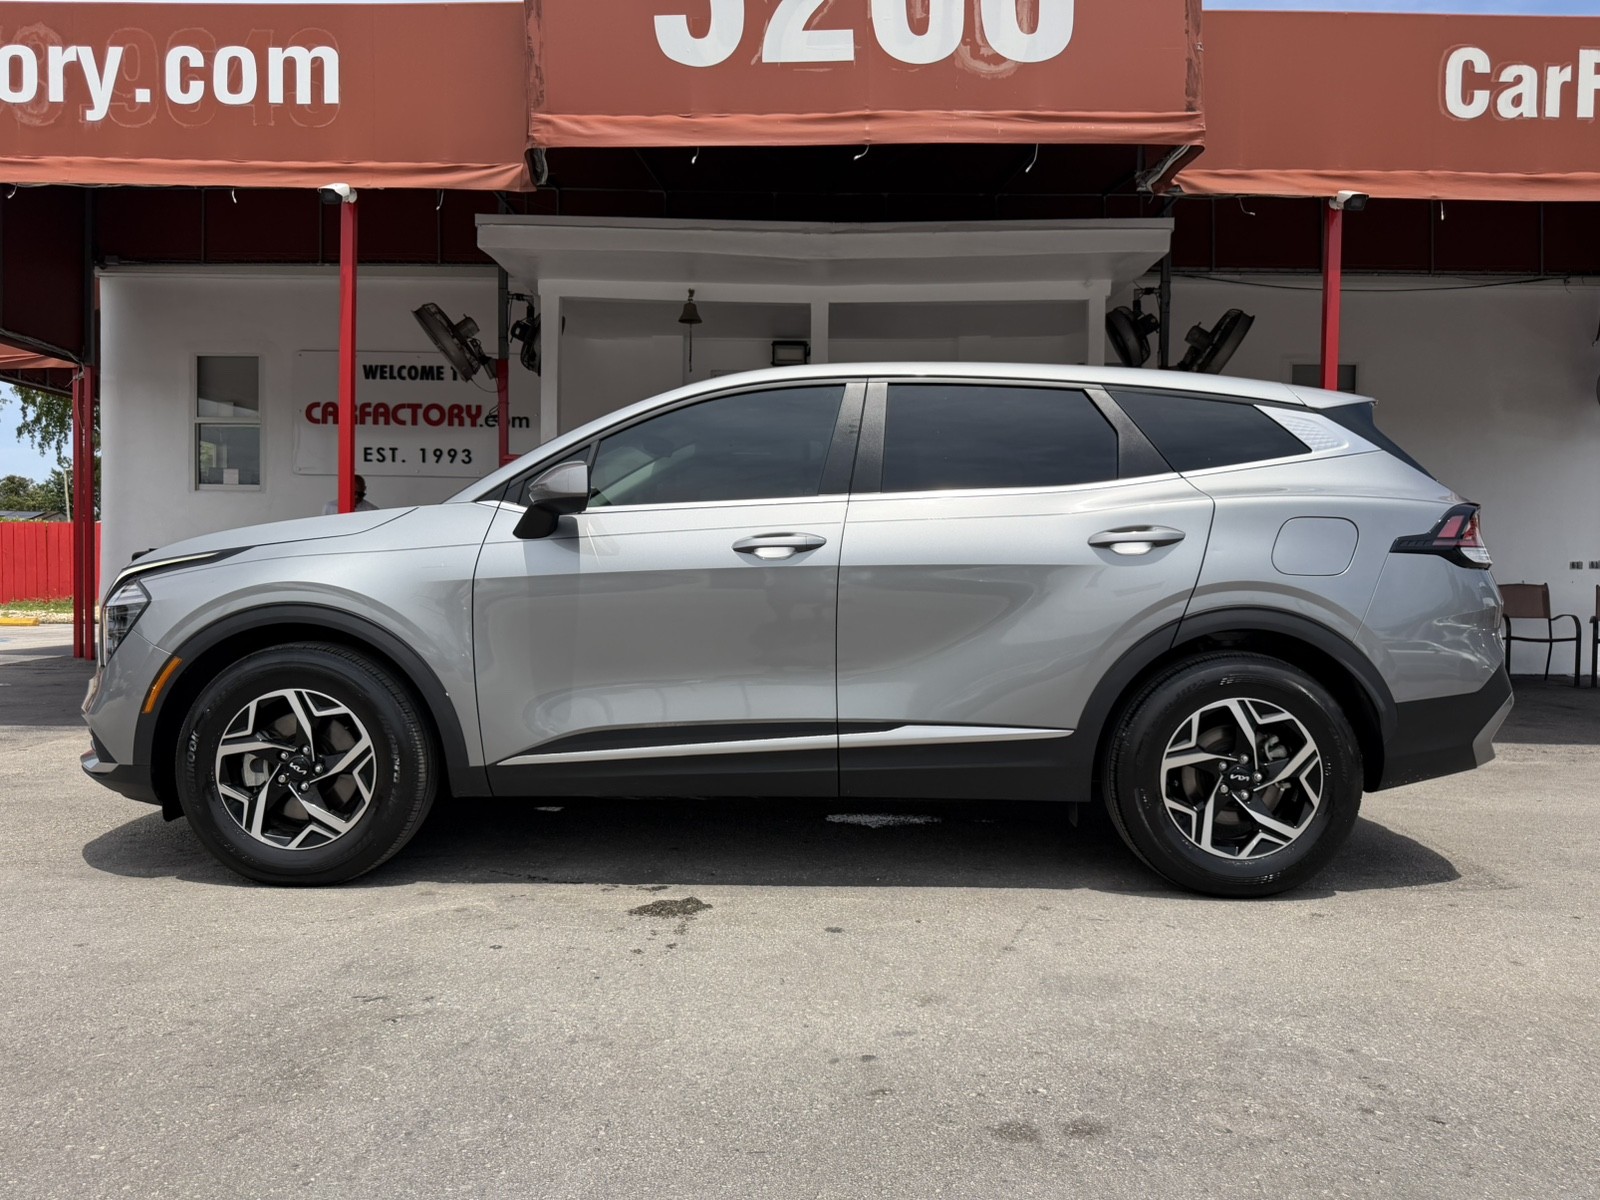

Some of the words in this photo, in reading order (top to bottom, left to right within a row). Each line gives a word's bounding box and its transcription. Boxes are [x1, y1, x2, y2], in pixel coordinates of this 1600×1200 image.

[0, 44, 340, 122] ory.com
[362, 364, 445, 381] WELCOME
[305, 401, 530, 428] CAFACTORY.cm
[363, 446, 406, 463] EST.
[419, 447, 473, 465] 1993
